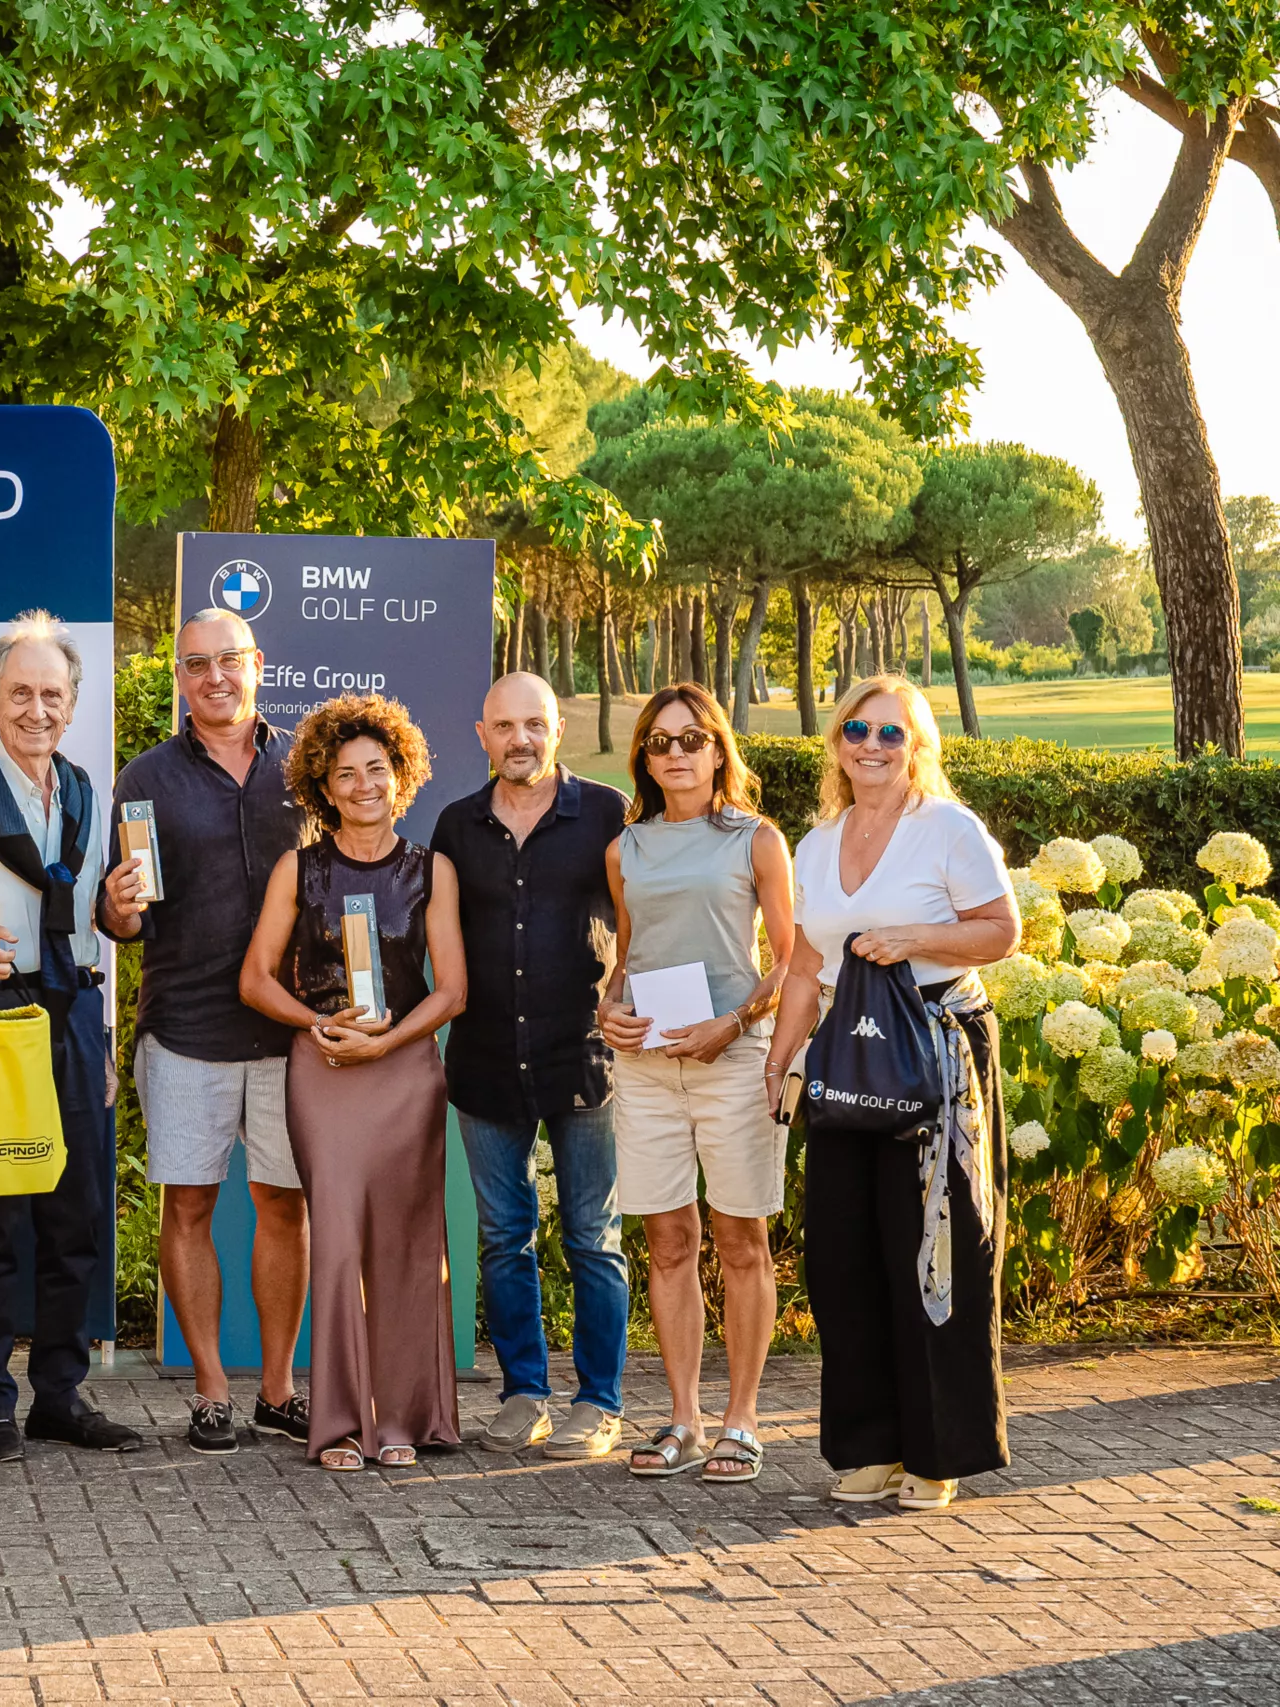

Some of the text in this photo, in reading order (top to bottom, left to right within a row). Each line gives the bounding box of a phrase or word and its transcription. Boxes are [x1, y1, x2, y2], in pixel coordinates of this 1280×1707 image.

[219, 562, 264, 581] BMW
[302, 566, 371, 589] BMW
[301, 597, 437, 622] GOLF CUP
[261, 665, 385, 694] Effe Group
[825, 1088, 923, 1112] BMW GOLF CUP
